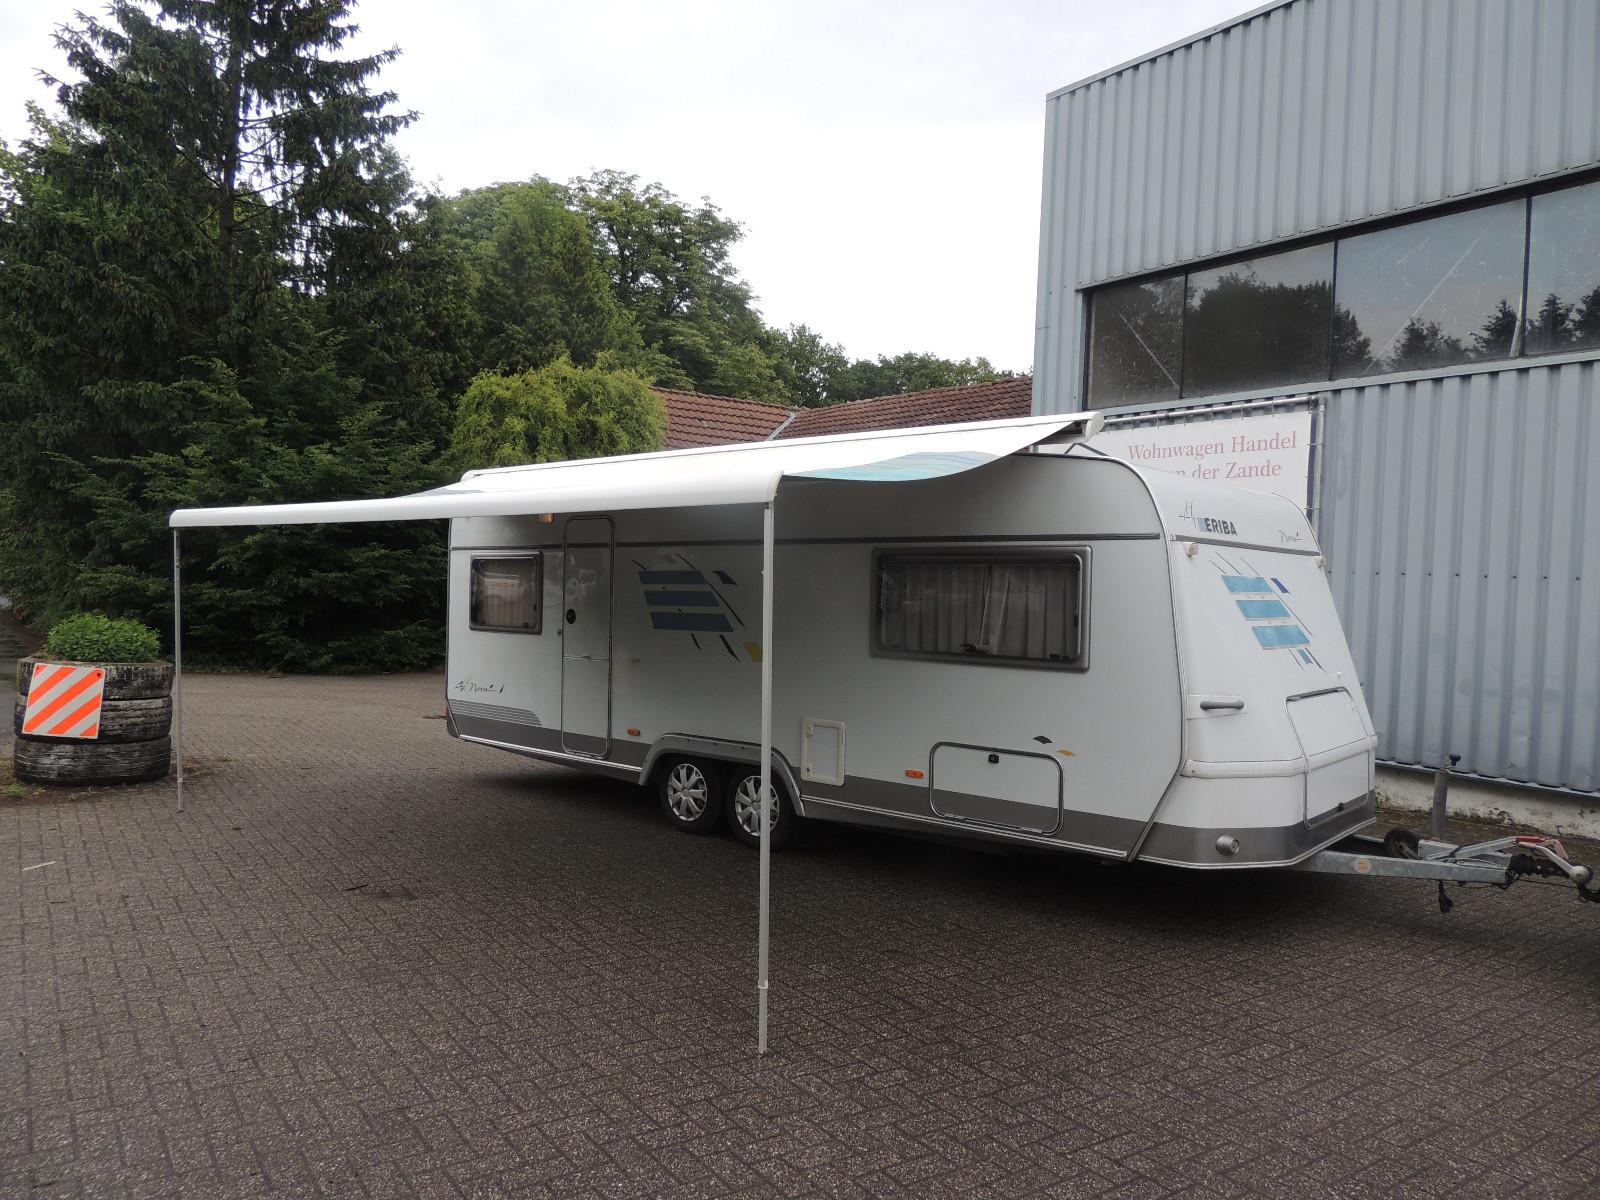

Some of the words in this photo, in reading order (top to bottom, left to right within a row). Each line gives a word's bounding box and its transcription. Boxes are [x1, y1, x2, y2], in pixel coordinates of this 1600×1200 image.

[1128, 442, 1224, 460] Wohnwagen
[1231, 431, 1297, 453] Handel
[1192, 464, 1220, 480] der
[1225, 460, 1282, 479] Zande
[1204, 518, 1238, 536] ERIBA
